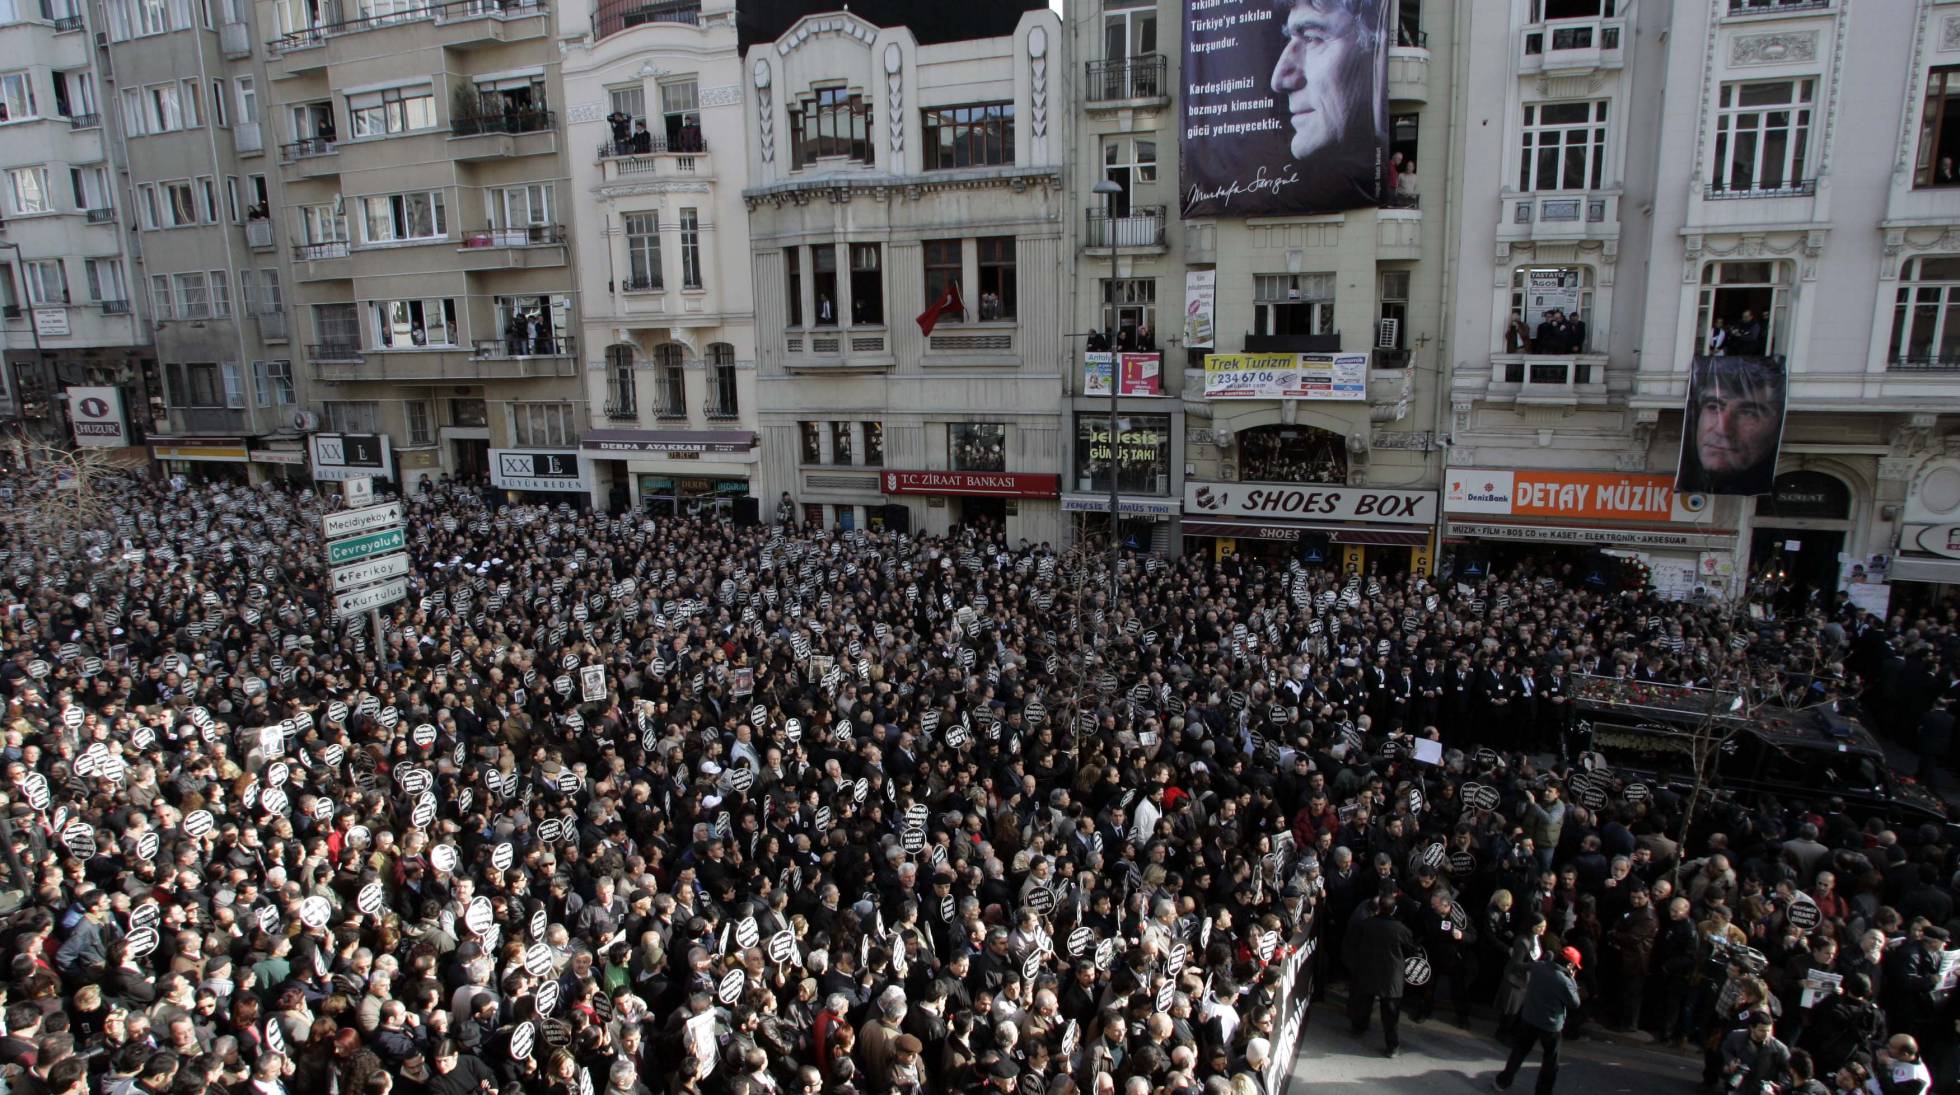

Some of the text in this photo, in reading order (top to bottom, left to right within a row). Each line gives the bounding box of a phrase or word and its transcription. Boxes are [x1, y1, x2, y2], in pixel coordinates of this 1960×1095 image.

[1191, 10, 1272, 31] Türkiye'ye sıkılan
[1190, 37, 1239, 54] kurşundur.
[1189, 76, 1254, 95] Kardeşliğimizi
[1189, 97, 1273, 116] bozmaya kimsenin
[1187, 118, 1282, 139] gücü yetmeyecektir.
[1211, 358, 1239, 370] Trek
[1245, 355, 1291, 369] Turizm
[1217, 371, 1273, 384] 234 67 06
[79, 423, 117, 434] HUZUR
[320, 443, 342, 459] XX
[646, 443, 706, 451] AYAKKABI
[1131, 449, 1155, 461] TAKI
[505, 458, 531, 473] XX
[501, 479, 582, 489] BÜYÜK BEDEN
[902, 473, 1015, 488] T.C. ZİRAAT BANKASI
[1241, 490, 1424, 517] SHOES BOX
[1468, 493, 1508, 503] DenizBank
[1517, 480, 1672, 513] DETAY MÜZİK
[329, 513, 387, 531] Mecidiyeköy
[1259, 528, 1300, 540] SHOES
[1452, 525, 1476, 534] MÜZİK
[1482, 527, 1500, 535] FİLM
[1525, 529, 1536, 537] CD
[1550, 531, 1577, 540] KASET
[1641, 535, 1687, 545] AKSESUAR
[333, 537, 391, 559] Çevreyolu
[949, 734, 966, 746] 301
